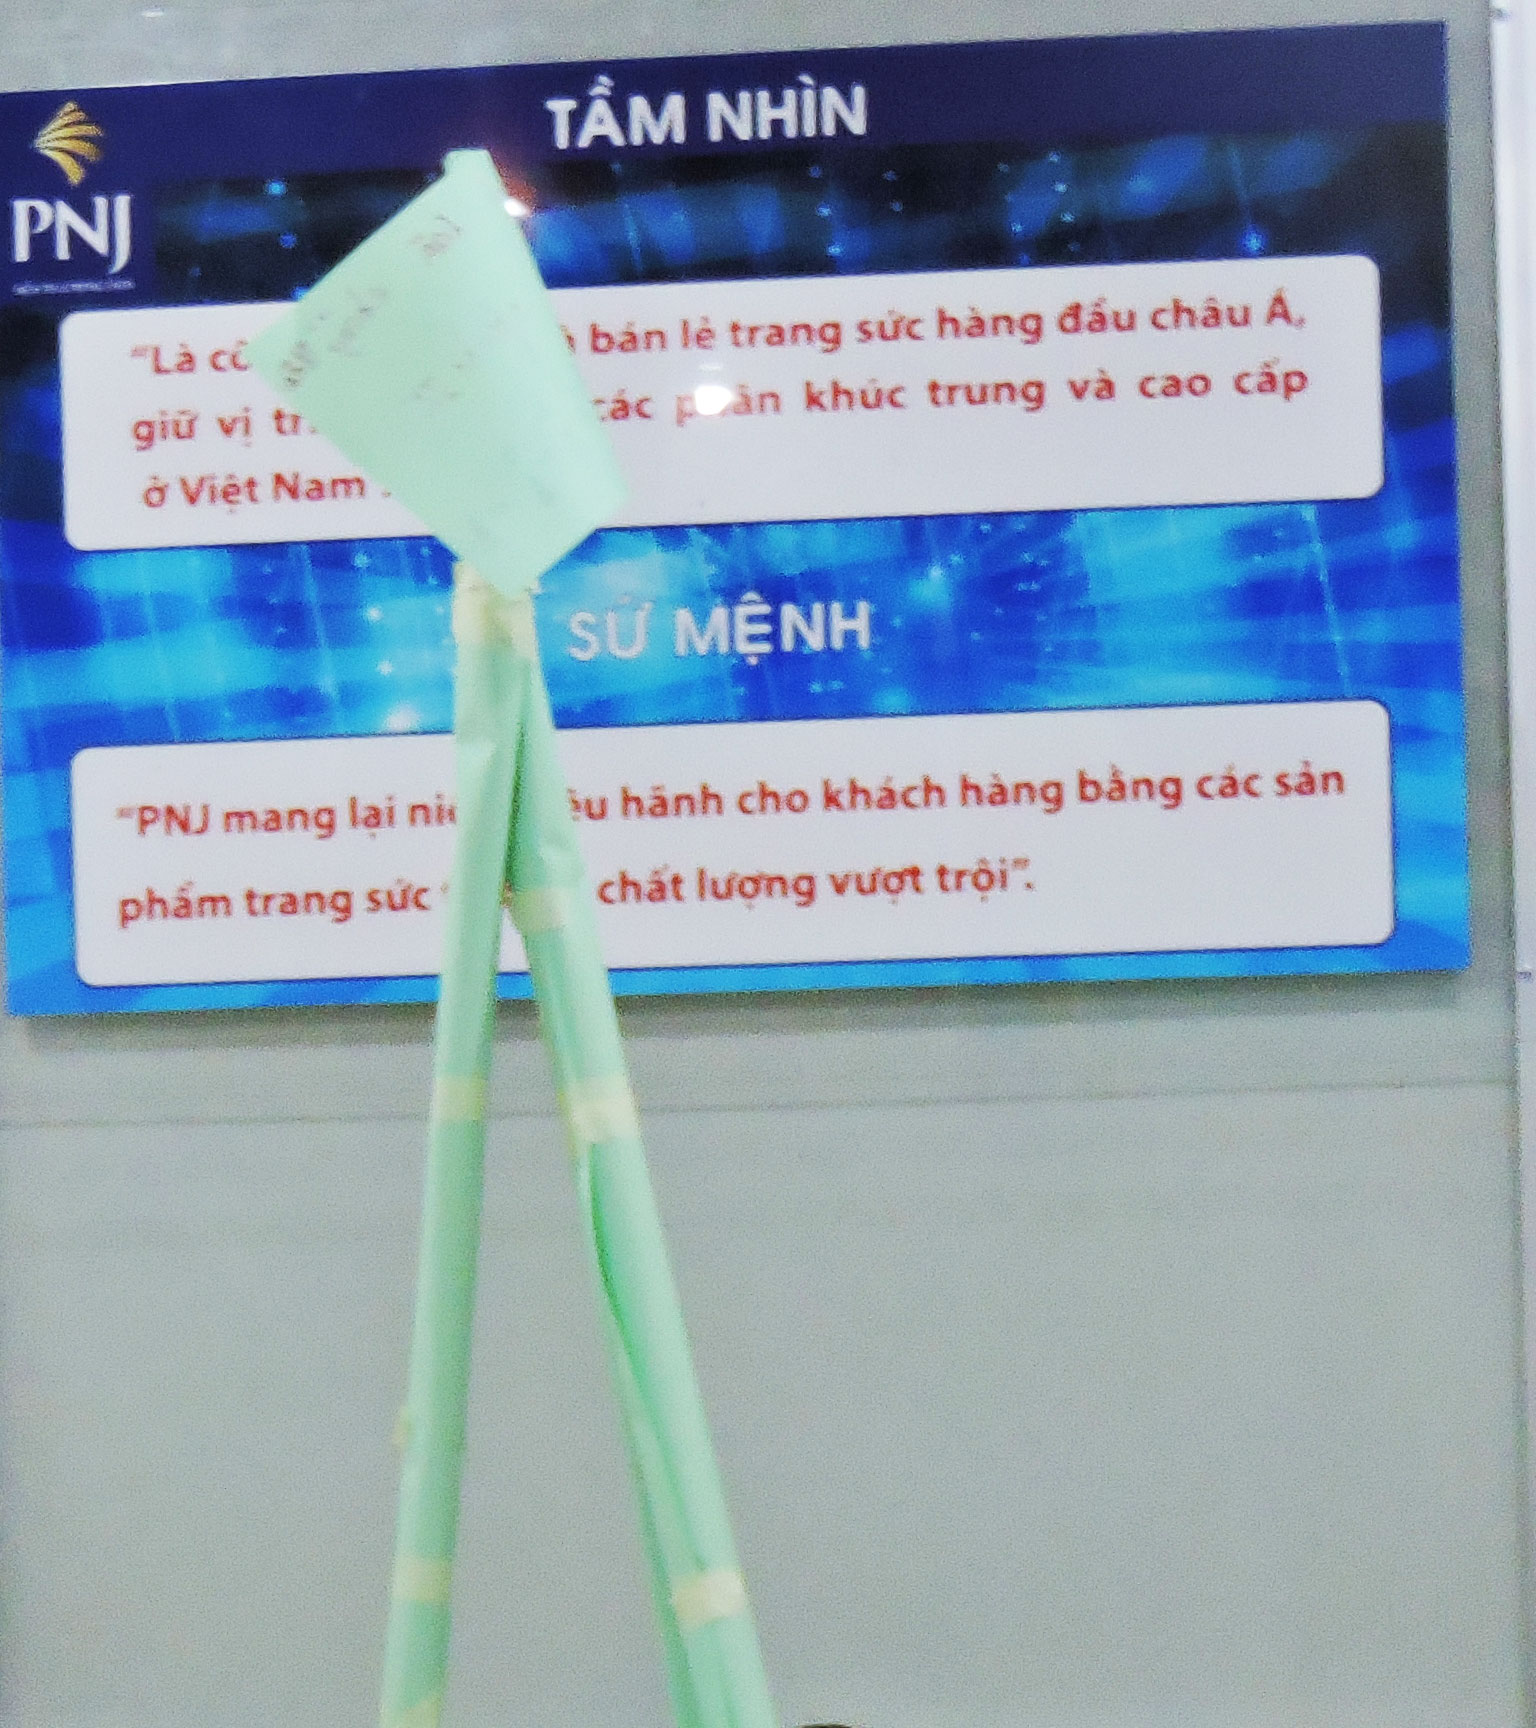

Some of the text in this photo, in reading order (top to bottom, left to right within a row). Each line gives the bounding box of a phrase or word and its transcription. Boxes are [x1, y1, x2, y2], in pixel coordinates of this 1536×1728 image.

[545, 72, 868, 150] TẦM NHÌN
[11, 195, 132, 275] PNJ
[730, 318, 843, 353] trang
[856, 308, 924, 343] sức
[934, 303, 1043, 345] hàng
[1150, 295, 1251, 331] châu
[804, 378, 907, 412] khúc
[927, 378, 1046, 412] trung
[1068, 367, 1116, 401] và
[1138, 373, 1213, 399] cao
[179, 473, 259, 514] Việt
[674, 590, 872, 666] MỆNH
[222, 805, 337, 841] mang
[348, 793, 396, 840] lại
[620, 783, 725, 821] hãnh
[737, 779, 809, 815] cho
[821, 774, 946, 812] khách
[960, 771, 1064, 815] hàng
[1195, 762, 1263, 800] các
[244, 887, 354, 924] trang
[366, 876, 433, 914] sức
[696, 865, 818, 911] lượng
[829, 865, 924, 906] vượt
